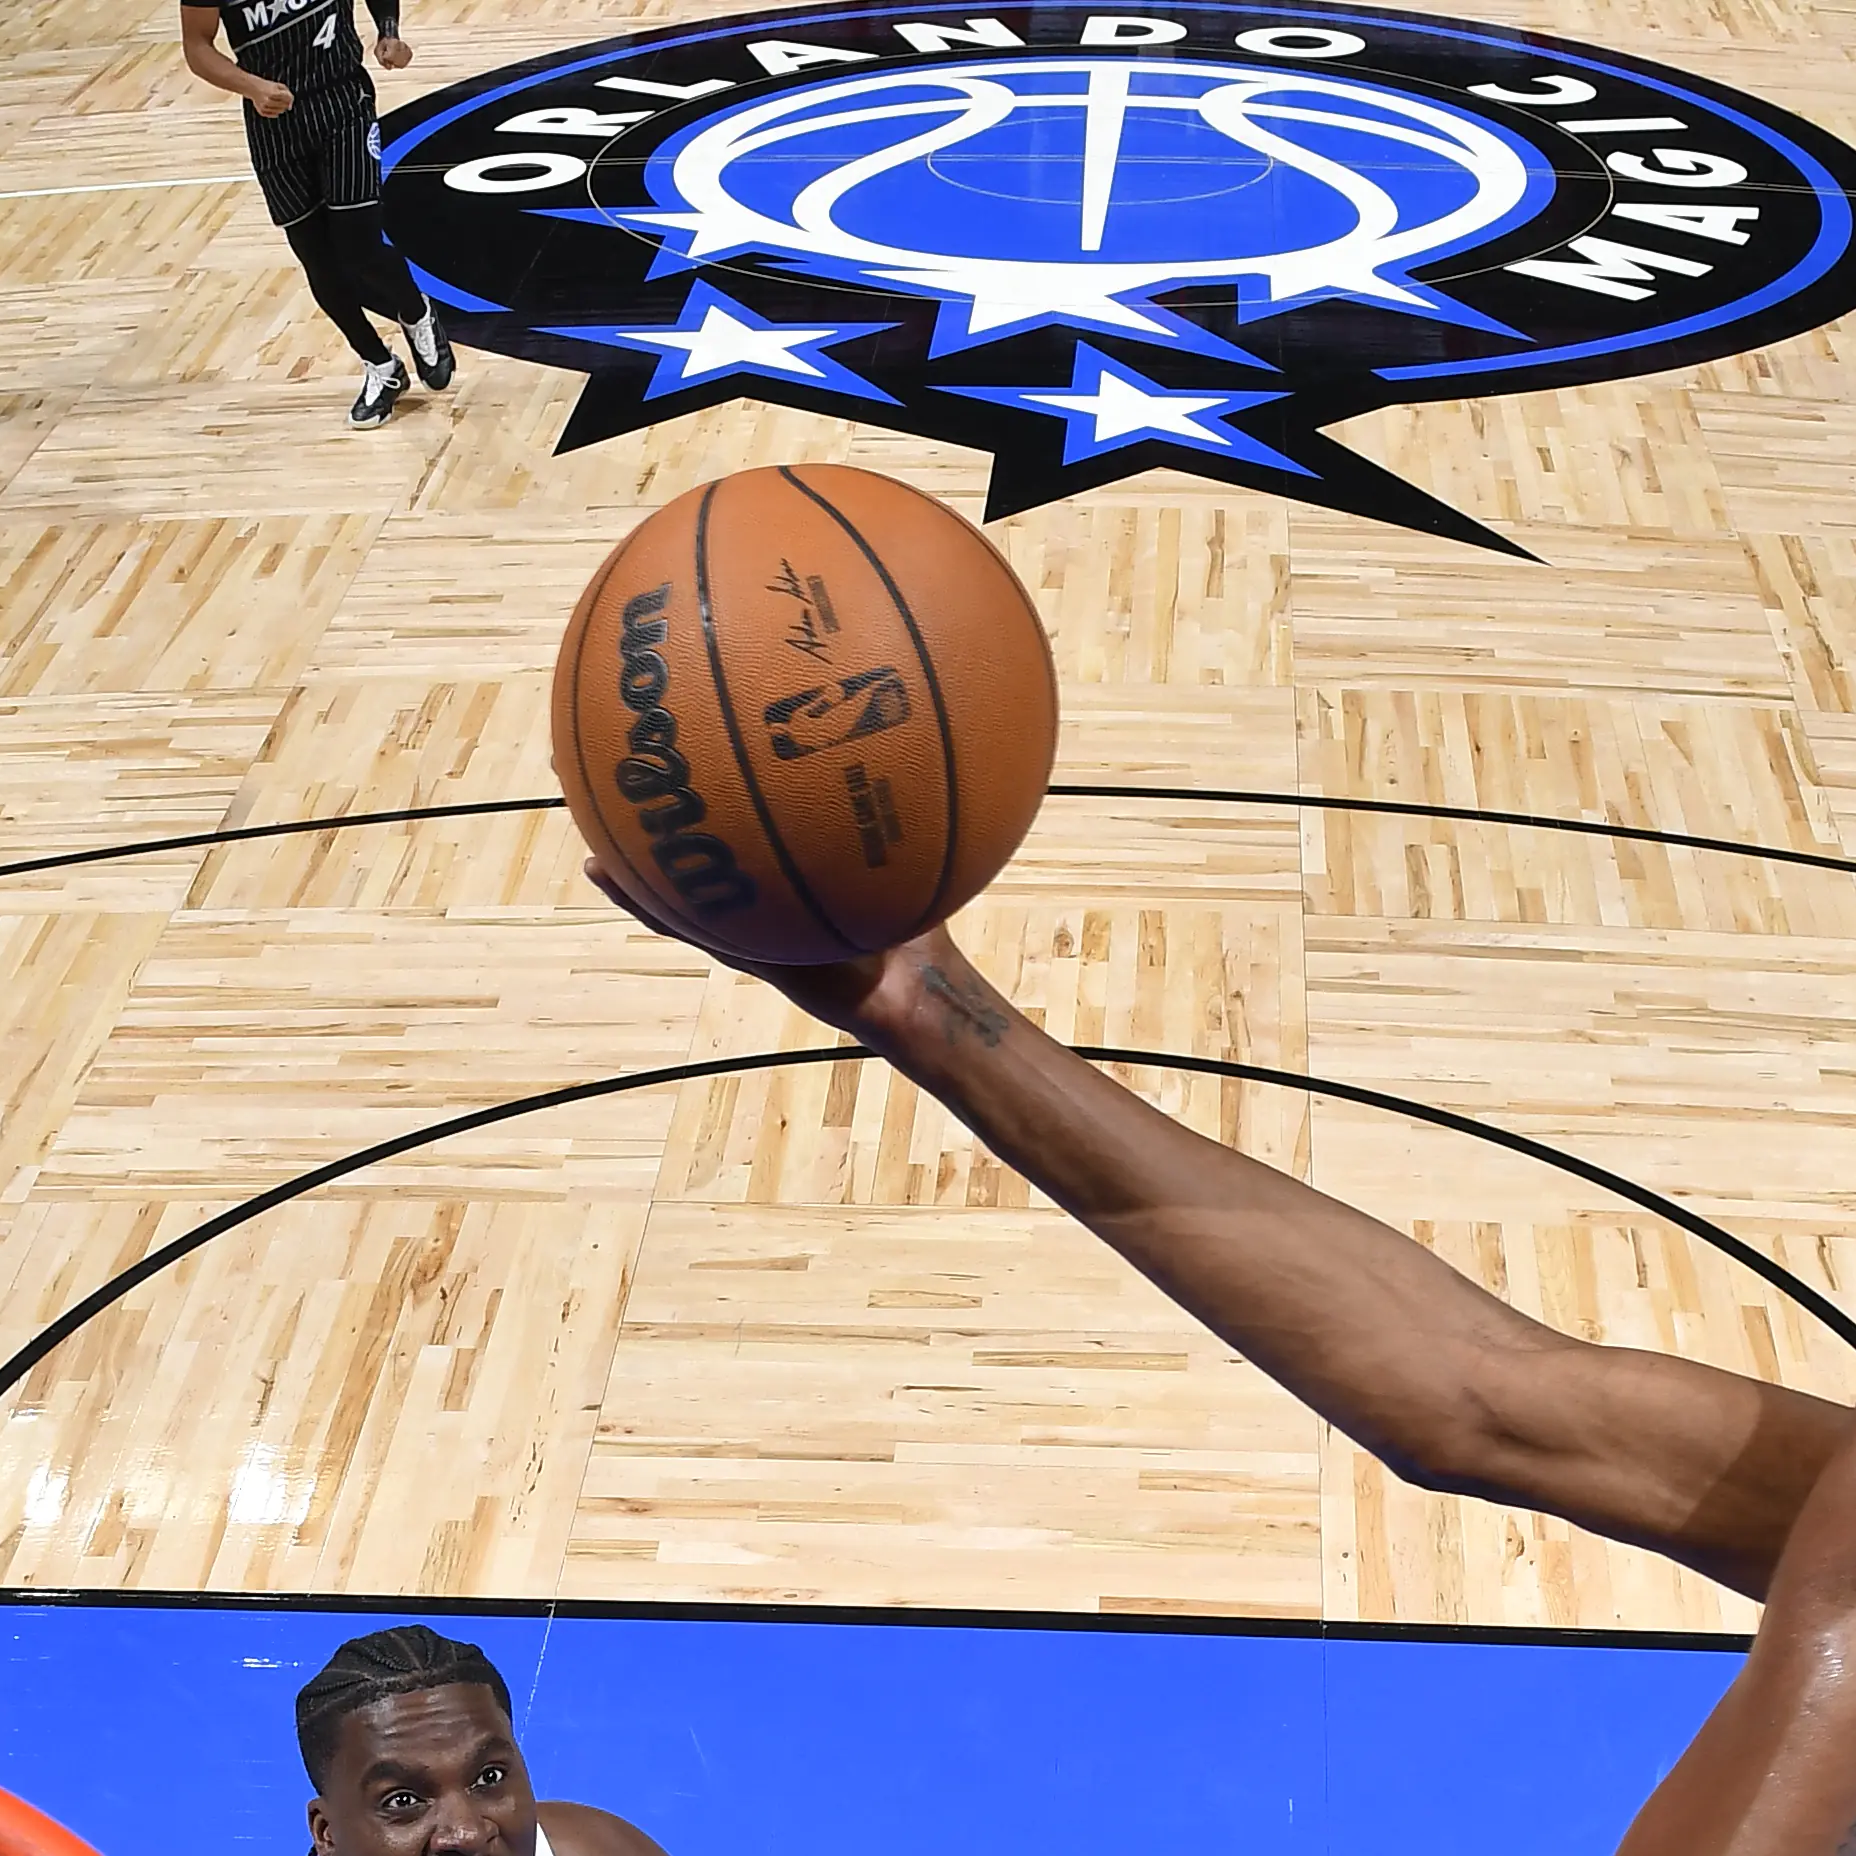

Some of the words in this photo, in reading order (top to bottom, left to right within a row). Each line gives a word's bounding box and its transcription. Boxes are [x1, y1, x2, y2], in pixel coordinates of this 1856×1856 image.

[312, 13, 337, 49] 4
[444, 15, 1366, 193] ORLANDO
[1468, 74, 1760, 301] MAGIC
